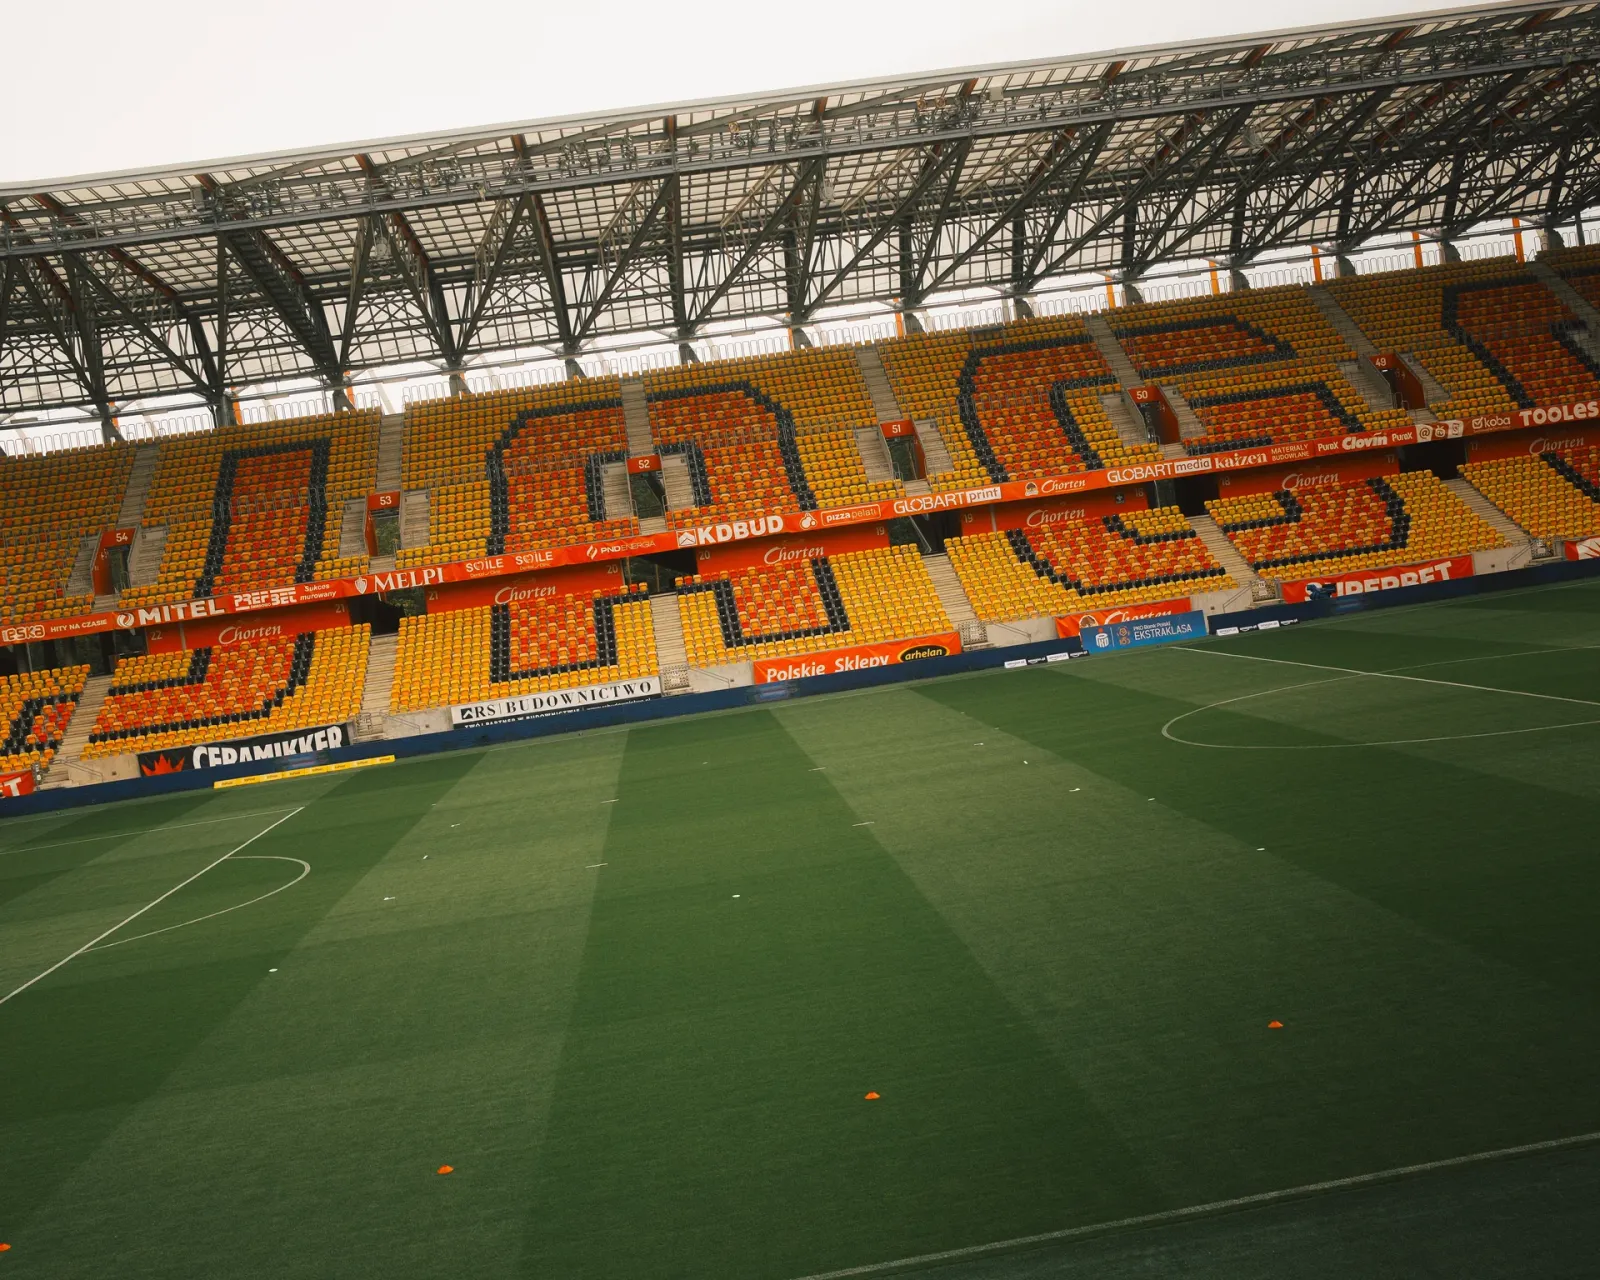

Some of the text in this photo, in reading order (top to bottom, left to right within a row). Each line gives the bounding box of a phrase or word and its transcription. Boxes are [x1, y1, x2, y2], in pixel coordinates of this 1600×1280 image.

[1375, 357, 1387, 367] 49
[1136, 390, 1148, 400] 50
[891, 424, 902, 434] 51
[1484, 416, 1511, 428] koba
[1341, 432, 1388, 451] Clovin
[1529, 436, 1584, 455] Chorten
[638, 459, 650, 469] 52
[1214, 452, 1268, 469] kaizen
[1107, 459, 1210, 483] GLOBART media
[1041, 479, 1086, 493] Chorten
[1281, 472, 1339, 491] Chorten
[379, 495, 392, 506] 53
[893, 488, 998, 514] GLOBART print
[1026, 508, 1085, 528] Chorten
[116, 532, 128, 543] 54
[698, 515, 784, 545] KDBUD
[763, 545, 824, 565] Chorten
[304, 583, 330, 593] Sukces
[373, 567, 445, 593] MELPI
[300, 590, 337, 602] murowany
[494, 584, 557, 605] Chorten
[138, 598, 225, 625] MITEL
[69, 623, 80, 631] NA
[82, 618, 107, 629] CZASIE
[218, 623, 282, 645] Chorten
[1133, 623, 1193, 641] EKSTRAKLASA
[904, 646, 943, 661] arhelan
[766, 661, 826, 683] Polskie
[475, 703, 496, 719] RS
[506, 681, 652, 714] BUDOWNICTWO
[192, 726, 342, 769] CERAMIKKER
[0, 777, 22, 798] T
